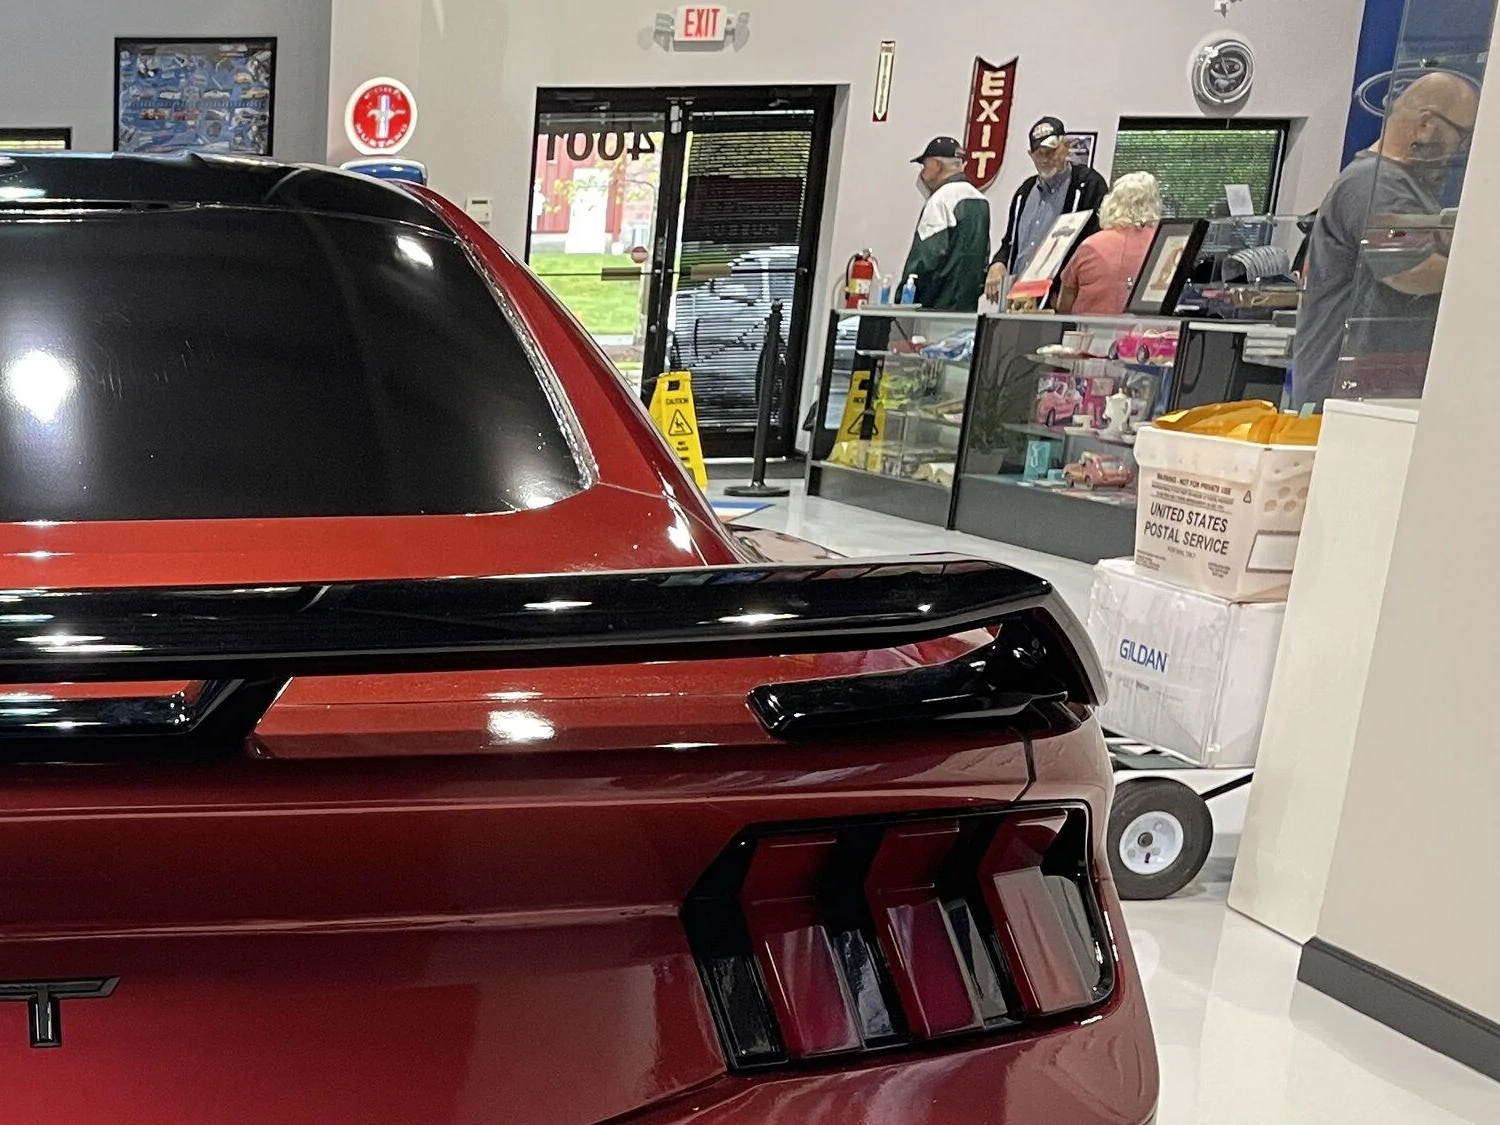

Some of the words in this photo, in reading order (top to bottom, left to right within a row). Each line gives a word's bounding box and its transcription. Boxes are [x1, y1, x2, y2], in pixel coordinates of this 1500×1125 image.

[684, 8, 720, 38] EXIT
[971, 70, 1007, 179] EXIT
[1150, 501, 1185, 523] UNITED
[1186, 510, 1228, 533] STATES
[1144, 520, 1180, 543] POSTAL
[1183, 531, 1230, 555] SERVICE
[1119, 639, 1168, 673] GILDAN
